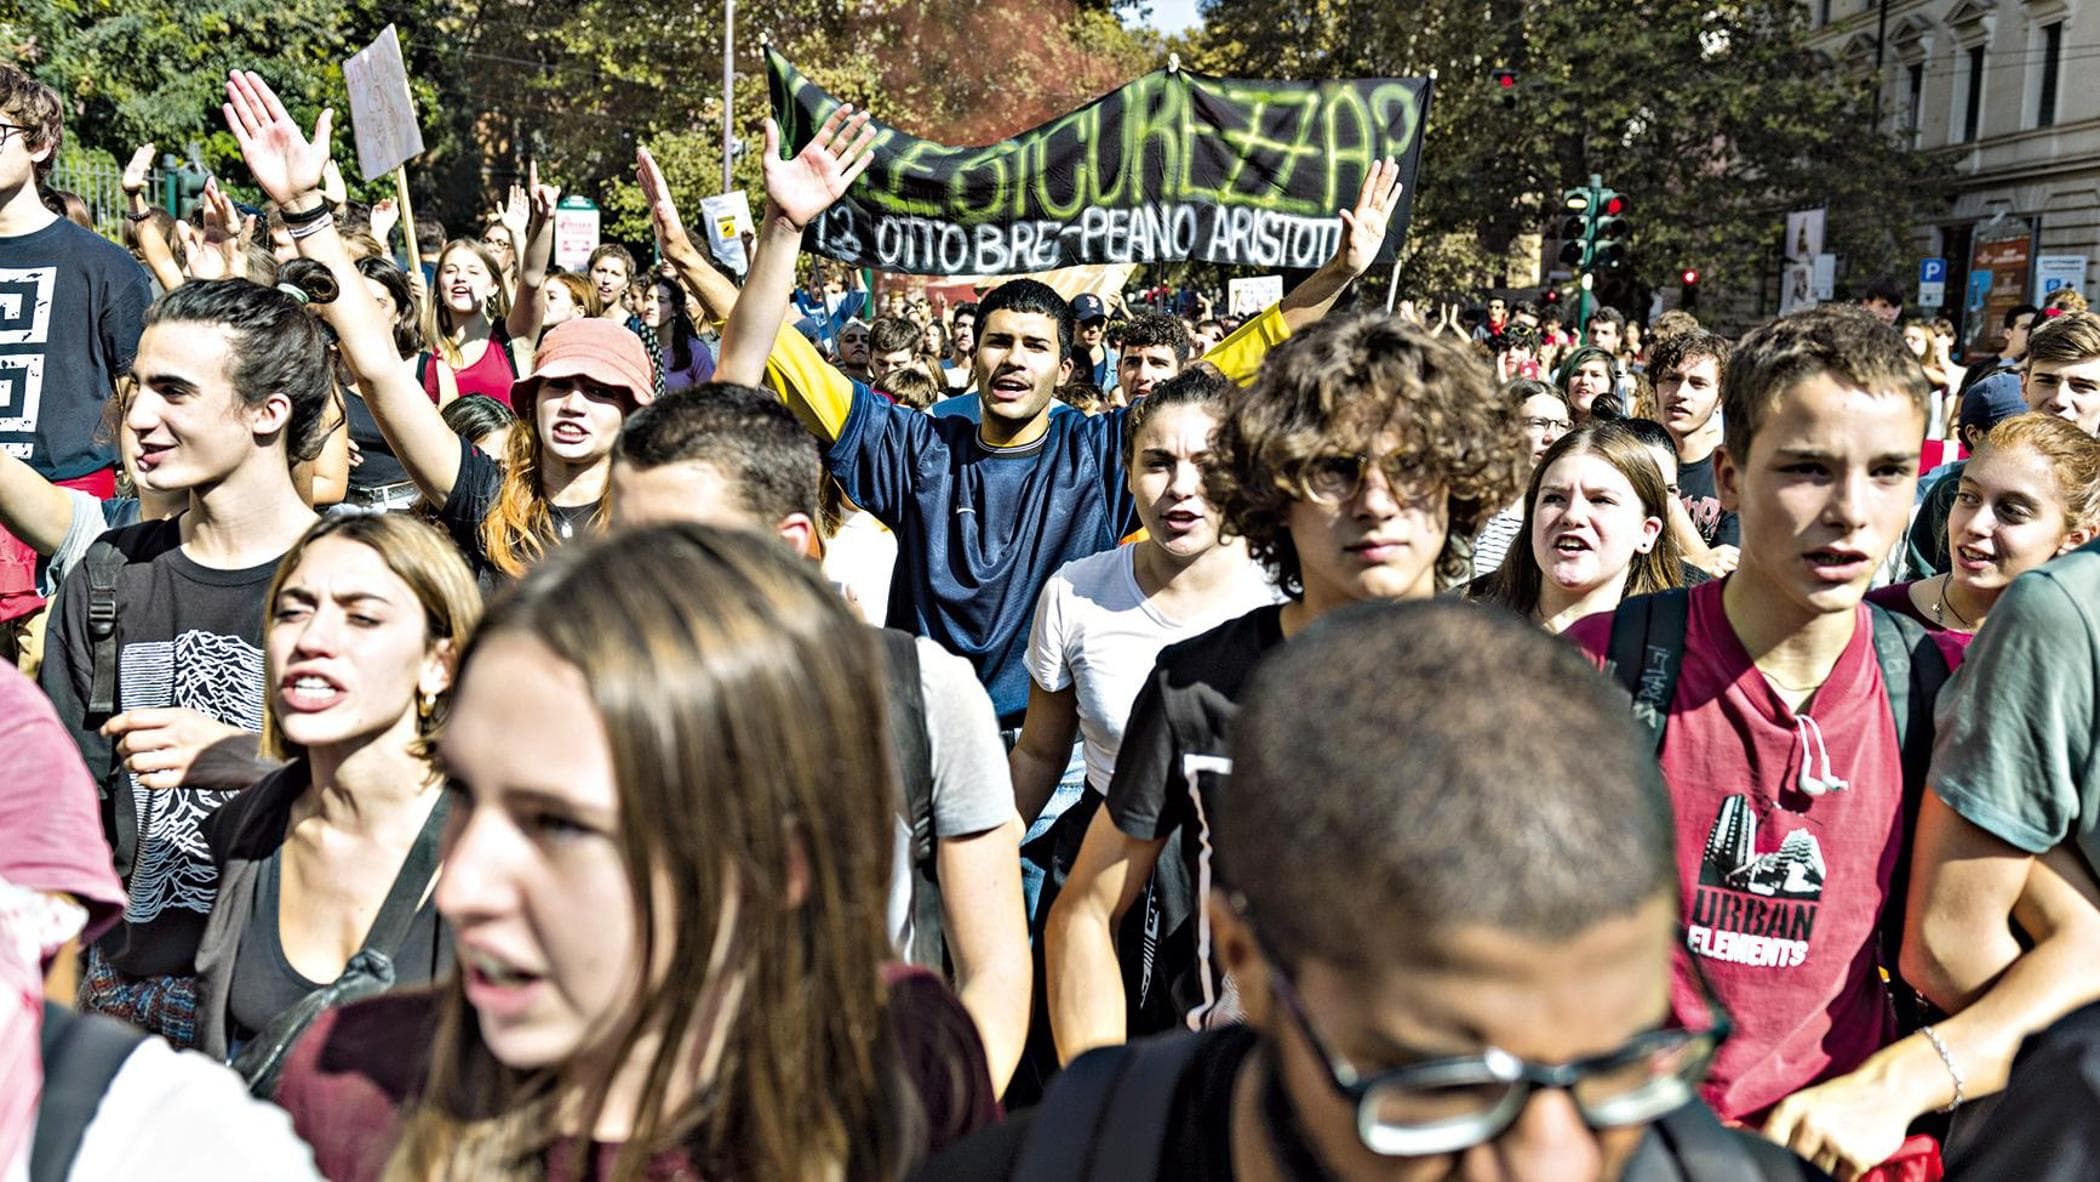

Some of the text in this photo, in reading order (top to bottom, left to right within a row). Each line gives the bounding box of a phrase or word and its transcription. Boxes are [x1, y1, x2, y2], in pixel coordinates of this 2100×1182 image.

[1206, 204, 1343, 267] ARISTOT
[1925, 262, 1941, 281] P
[1692, 888, 1818, 942] URBAN
[1686, 924, 1810, 968] ELEMENTS
